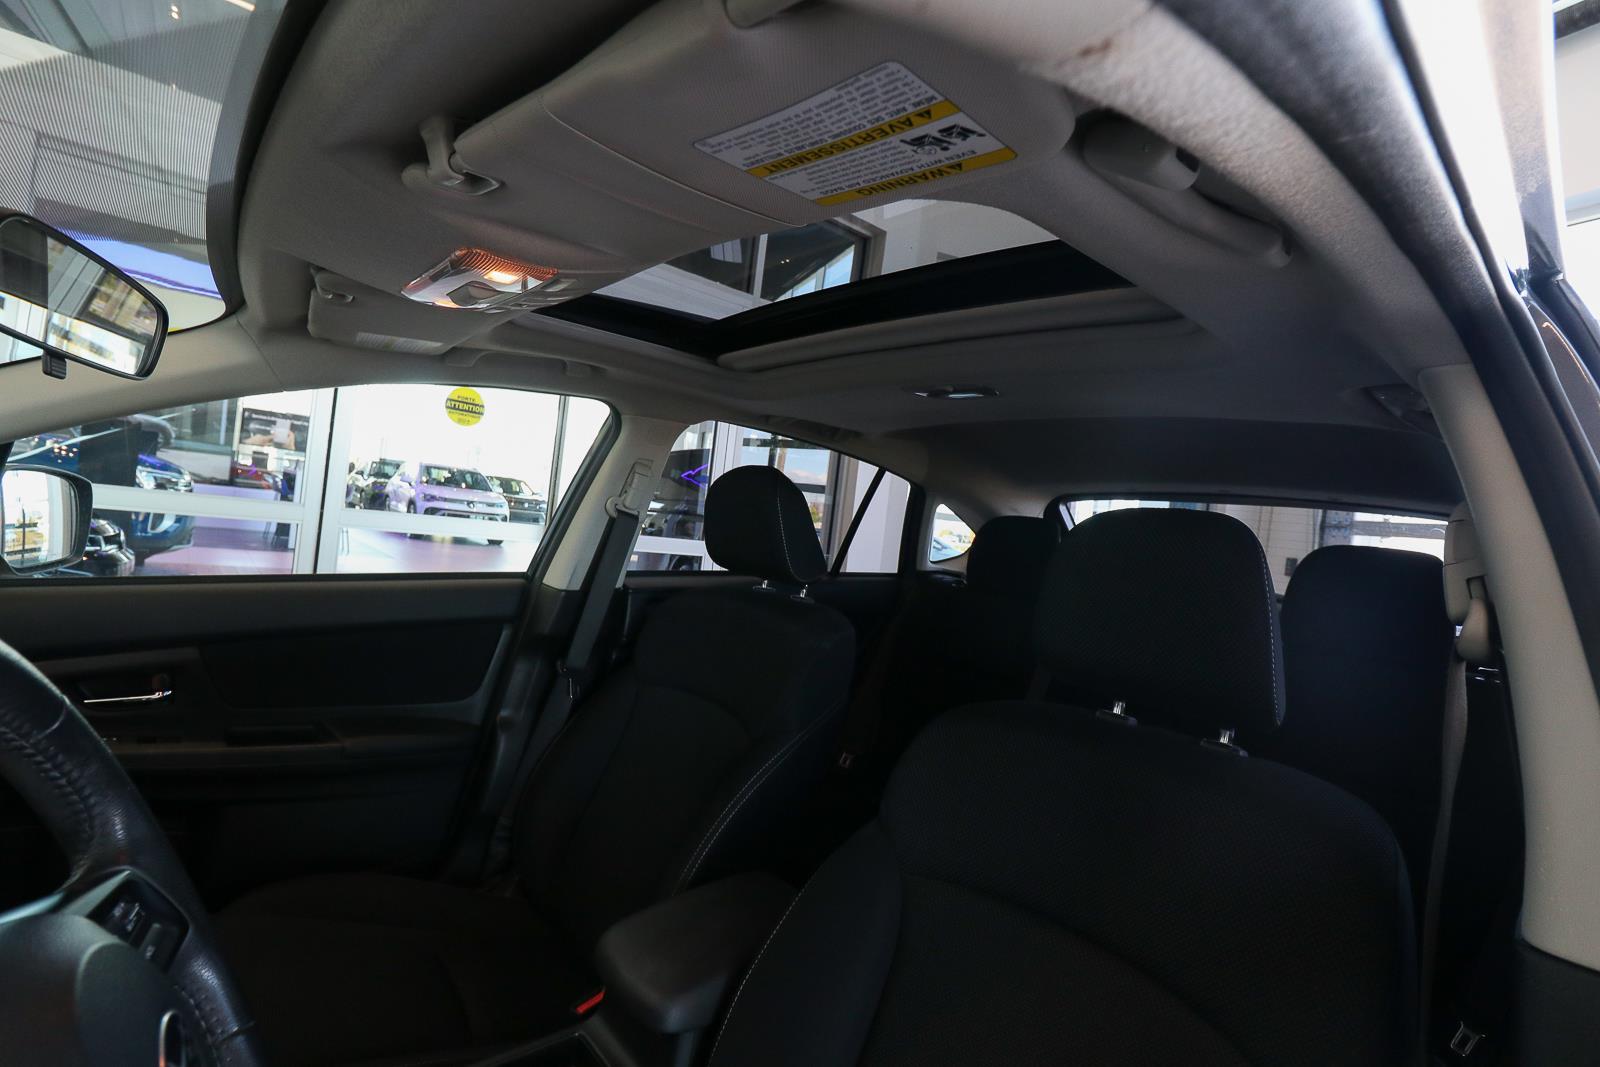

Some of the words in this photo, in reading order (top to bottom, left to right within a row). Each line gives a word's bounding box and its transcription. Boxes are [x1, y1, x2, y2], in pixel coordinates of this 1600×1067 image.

[761, 116, 912, 174] AVERTISSEMENT
[943, 149, 978, 161] EVEN
[914, 158, 946, 169] WITH
[854, 167, 951, 196] WARNING
[446, 400, 485, 414] ATTENTION
